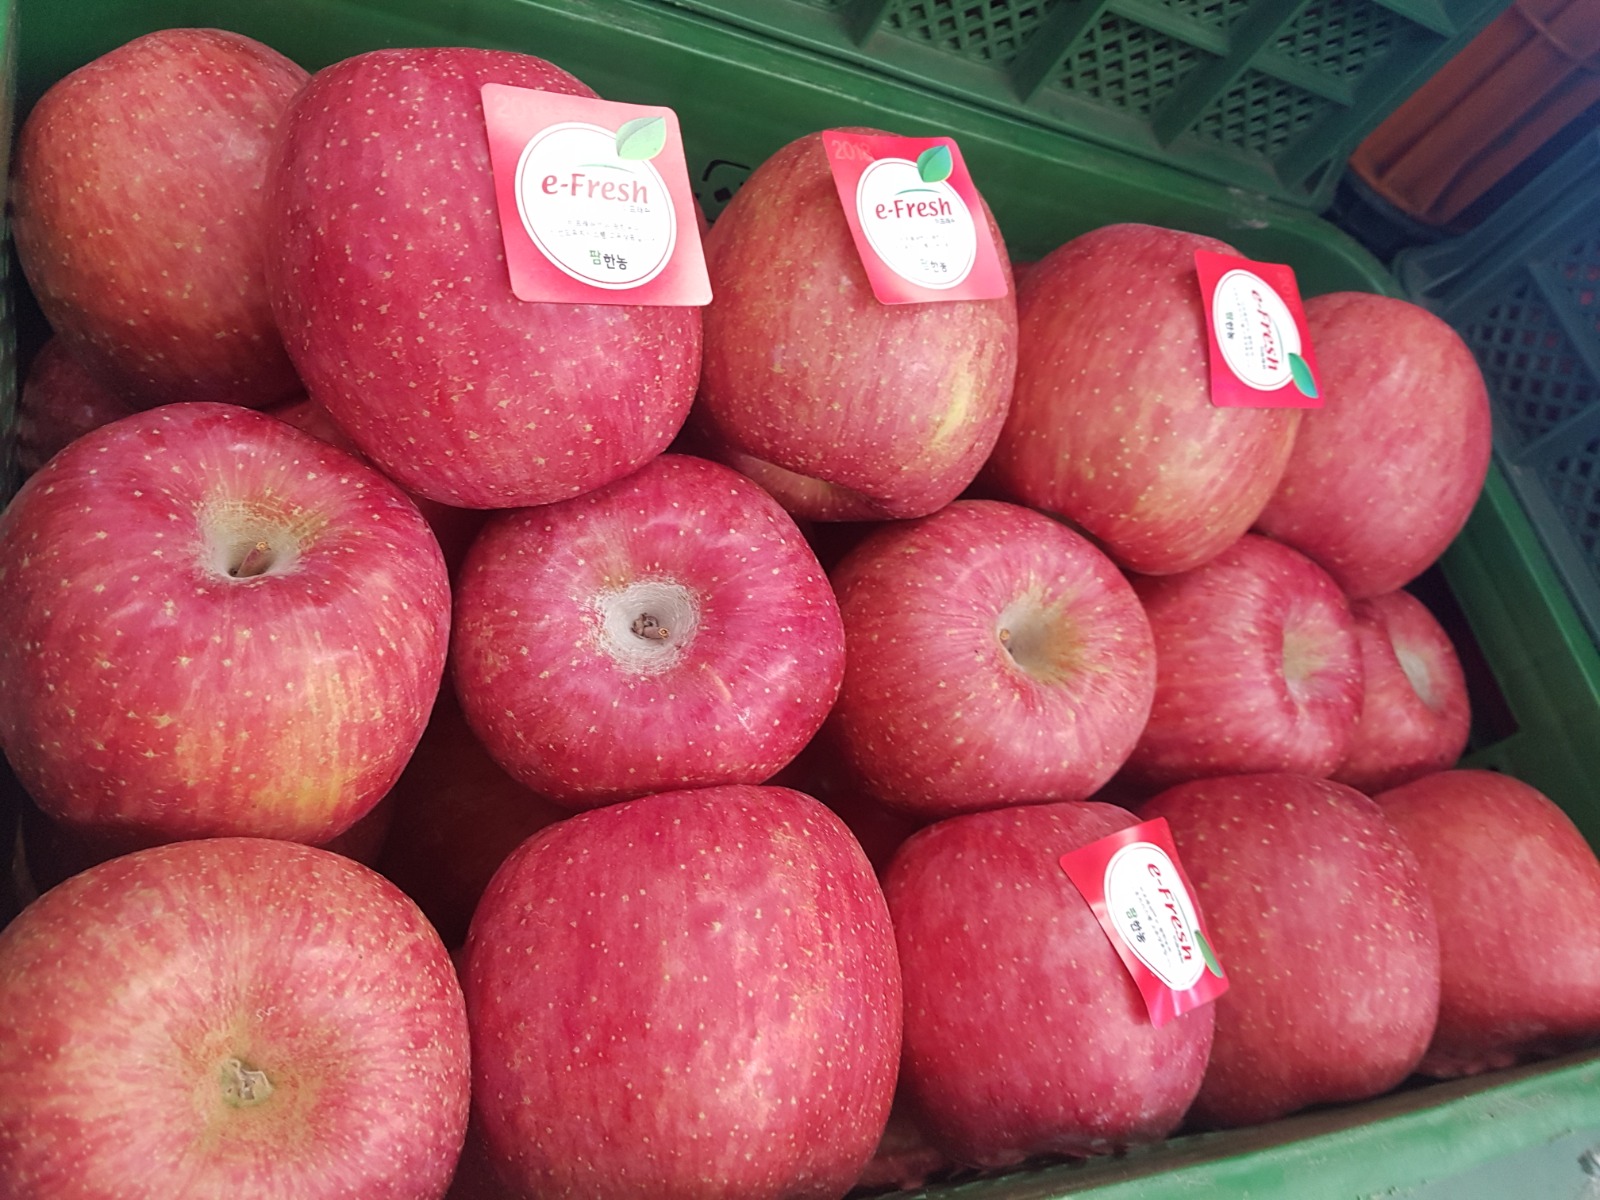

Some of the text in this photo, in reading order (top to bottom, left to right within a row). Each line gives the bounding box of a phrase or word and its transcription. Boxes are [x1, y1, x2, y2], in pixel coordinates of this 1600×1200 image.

[541, 173, 648, 204] e-Fresh
[875, 198, 952, 219] e-Fresh
[589, 249, 628, 271] 팜한농
[1147, 862, 1194, 961] e-Fresh
